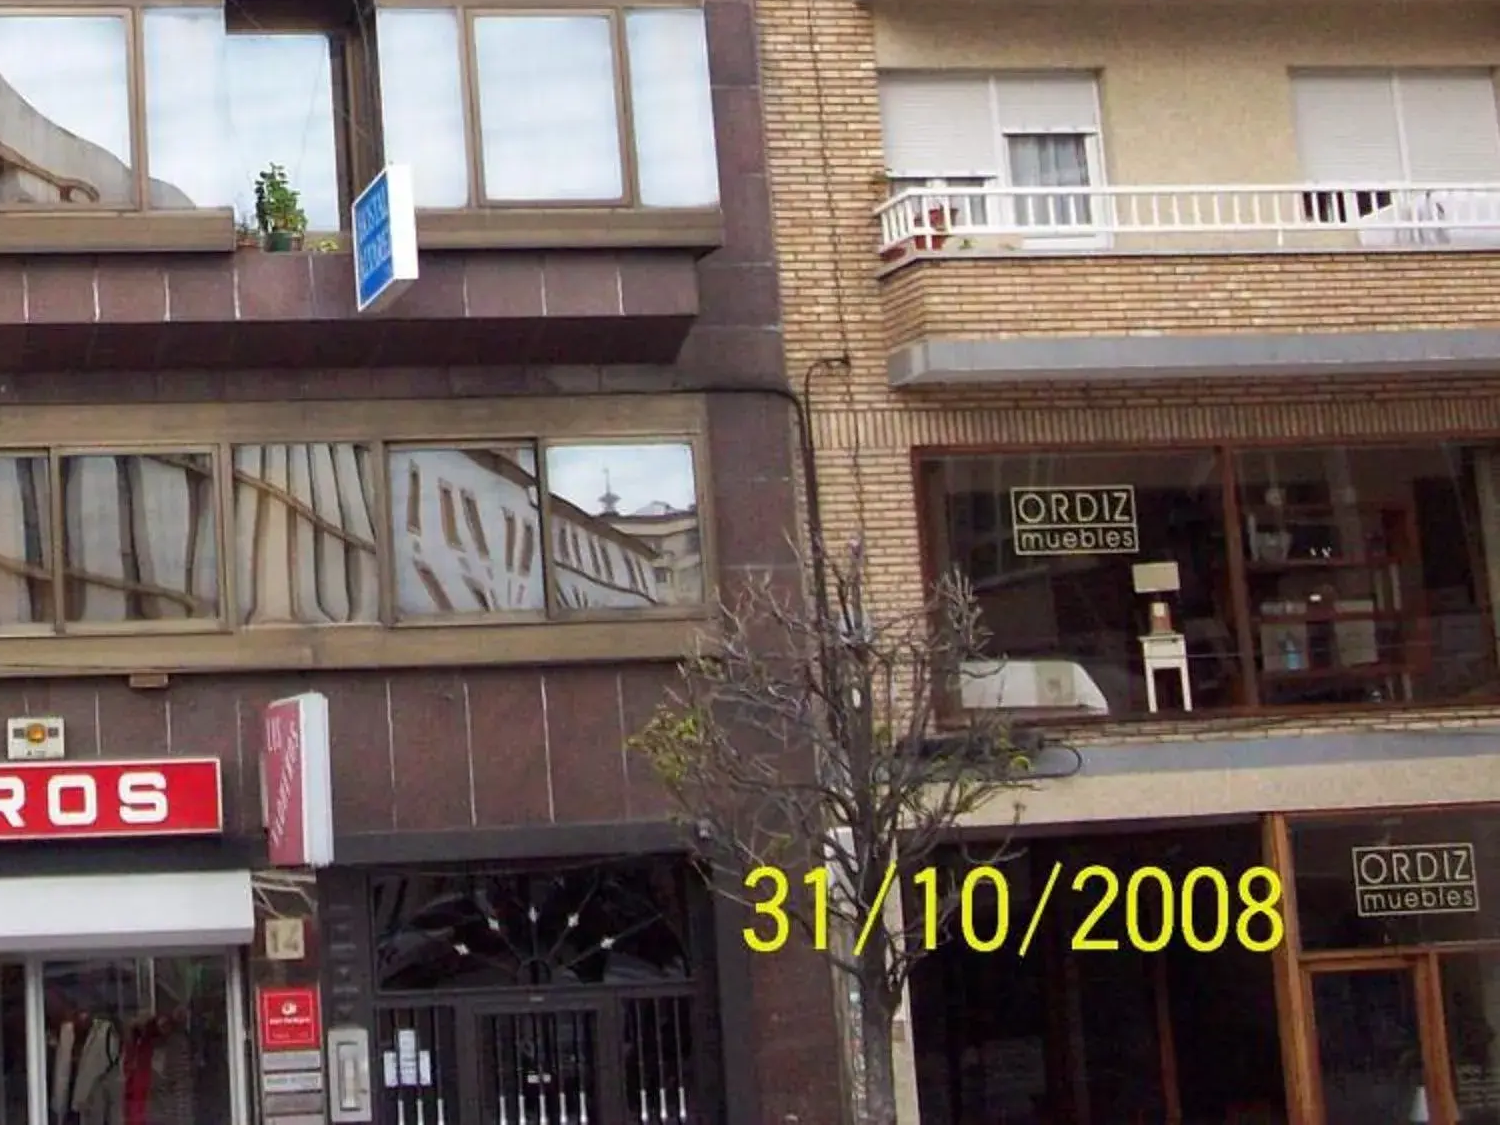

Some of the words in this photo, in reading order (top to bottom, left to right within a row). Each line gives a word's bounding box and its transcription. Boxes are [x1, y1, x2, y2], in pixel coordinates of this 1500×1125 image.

[1018, 491, 1131, 523] ORDIZ
[1021, 528, 1134, 550] muebles
[1360, 850, 1471, 883] ORDIZ
[1363, 886, 1474, 910] muebles
[270, 927, 299, 953] 14
